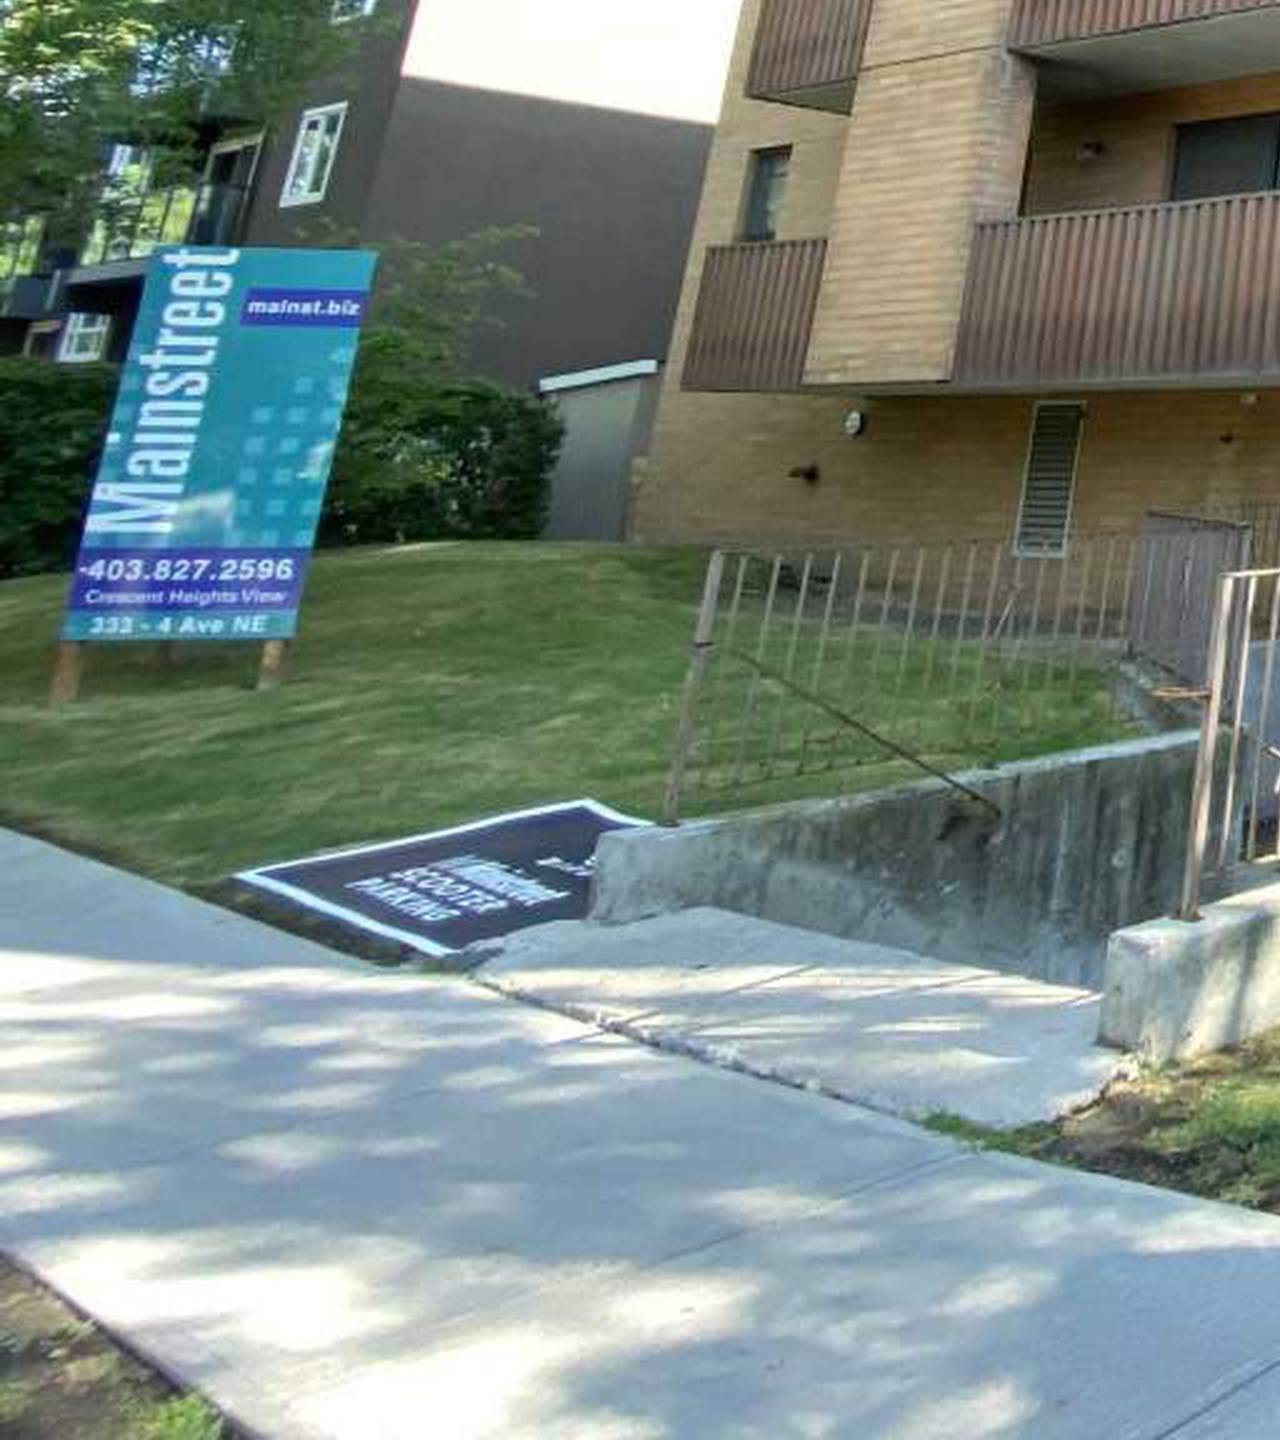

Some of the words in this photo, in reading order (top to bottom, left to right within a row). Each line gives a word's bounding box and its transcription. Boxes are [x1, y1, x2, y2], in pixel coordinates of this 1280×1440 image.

[247, 298, 361, 317] mainst.biz
[86, 247, 241, 535] Mainstreet
[88, 558, 294, 581] 403.827.2596
[240, 589, 287, 604] View
[231, 614, 269, 634] NE
